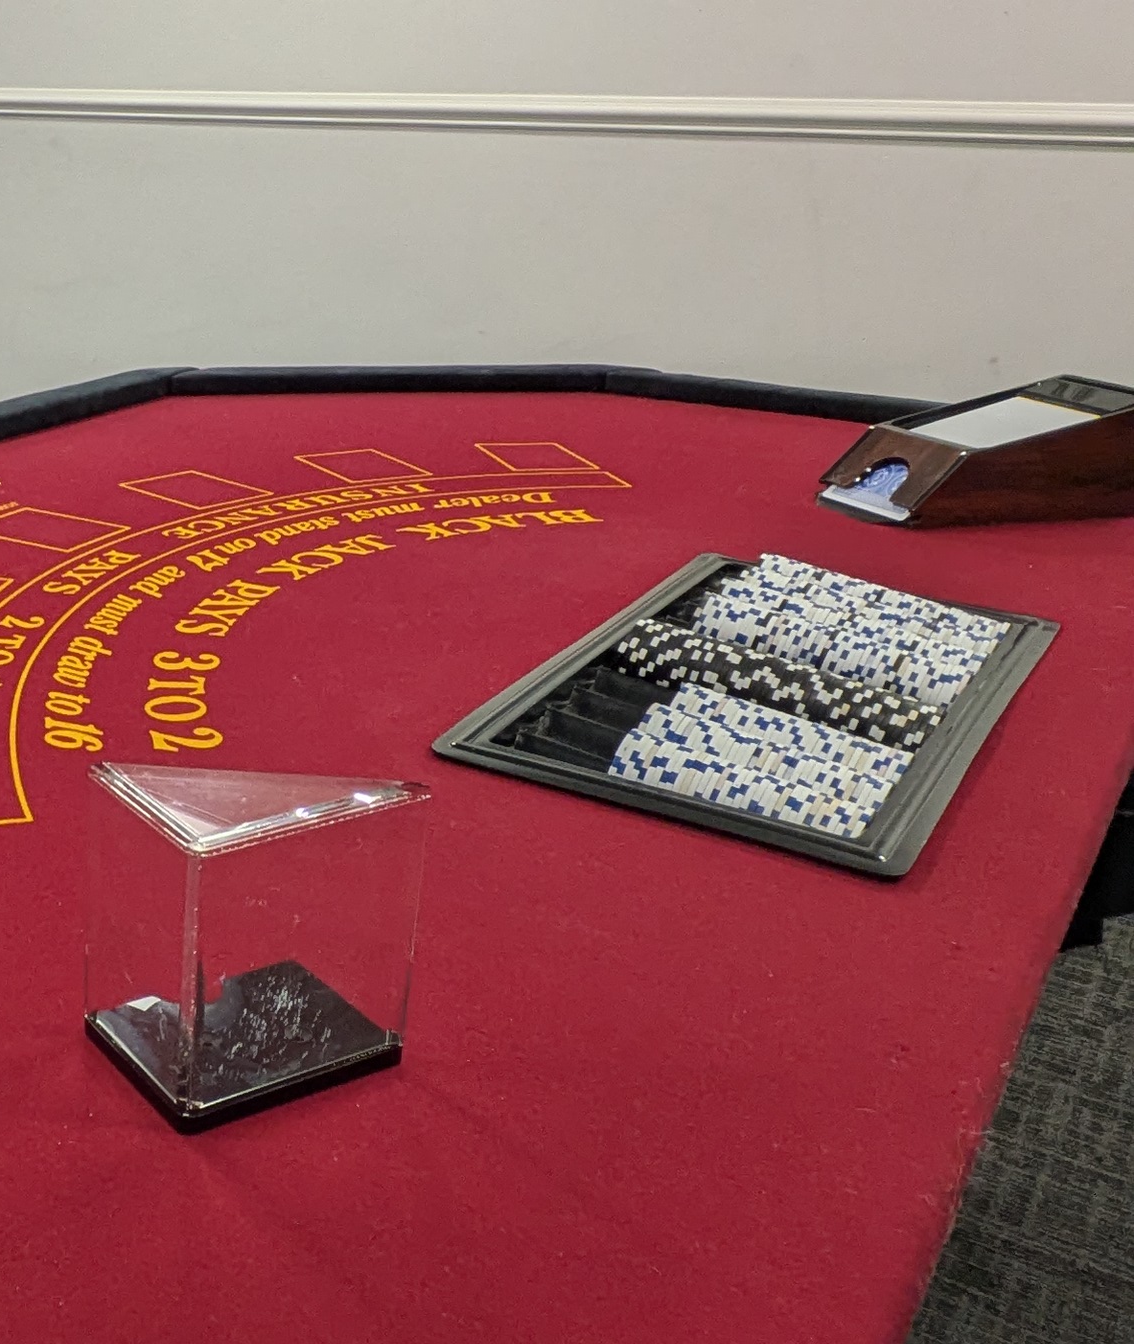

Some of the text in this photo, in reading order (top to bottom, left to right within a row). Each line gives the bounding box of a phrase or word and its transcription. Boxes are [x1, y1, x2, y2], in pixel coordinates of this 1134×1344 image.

[161, 483, 435, 540] INSURANCE
[340, 502, 426, 523] must
[433, 491, 556, 509] Dealer
[253, 515, 340, 546] stand
[42, 549, 142, 595] PAYS
[128, 565, 186, 599] and
[83, 593, 143, 636] must
[143, 508, 604, 753] BLACK JACK PAYS 3 TO 2
[52, 635, 113, 689] draw
[44, 691, 91, 716] to
[43, 716, 104, 752] 16
